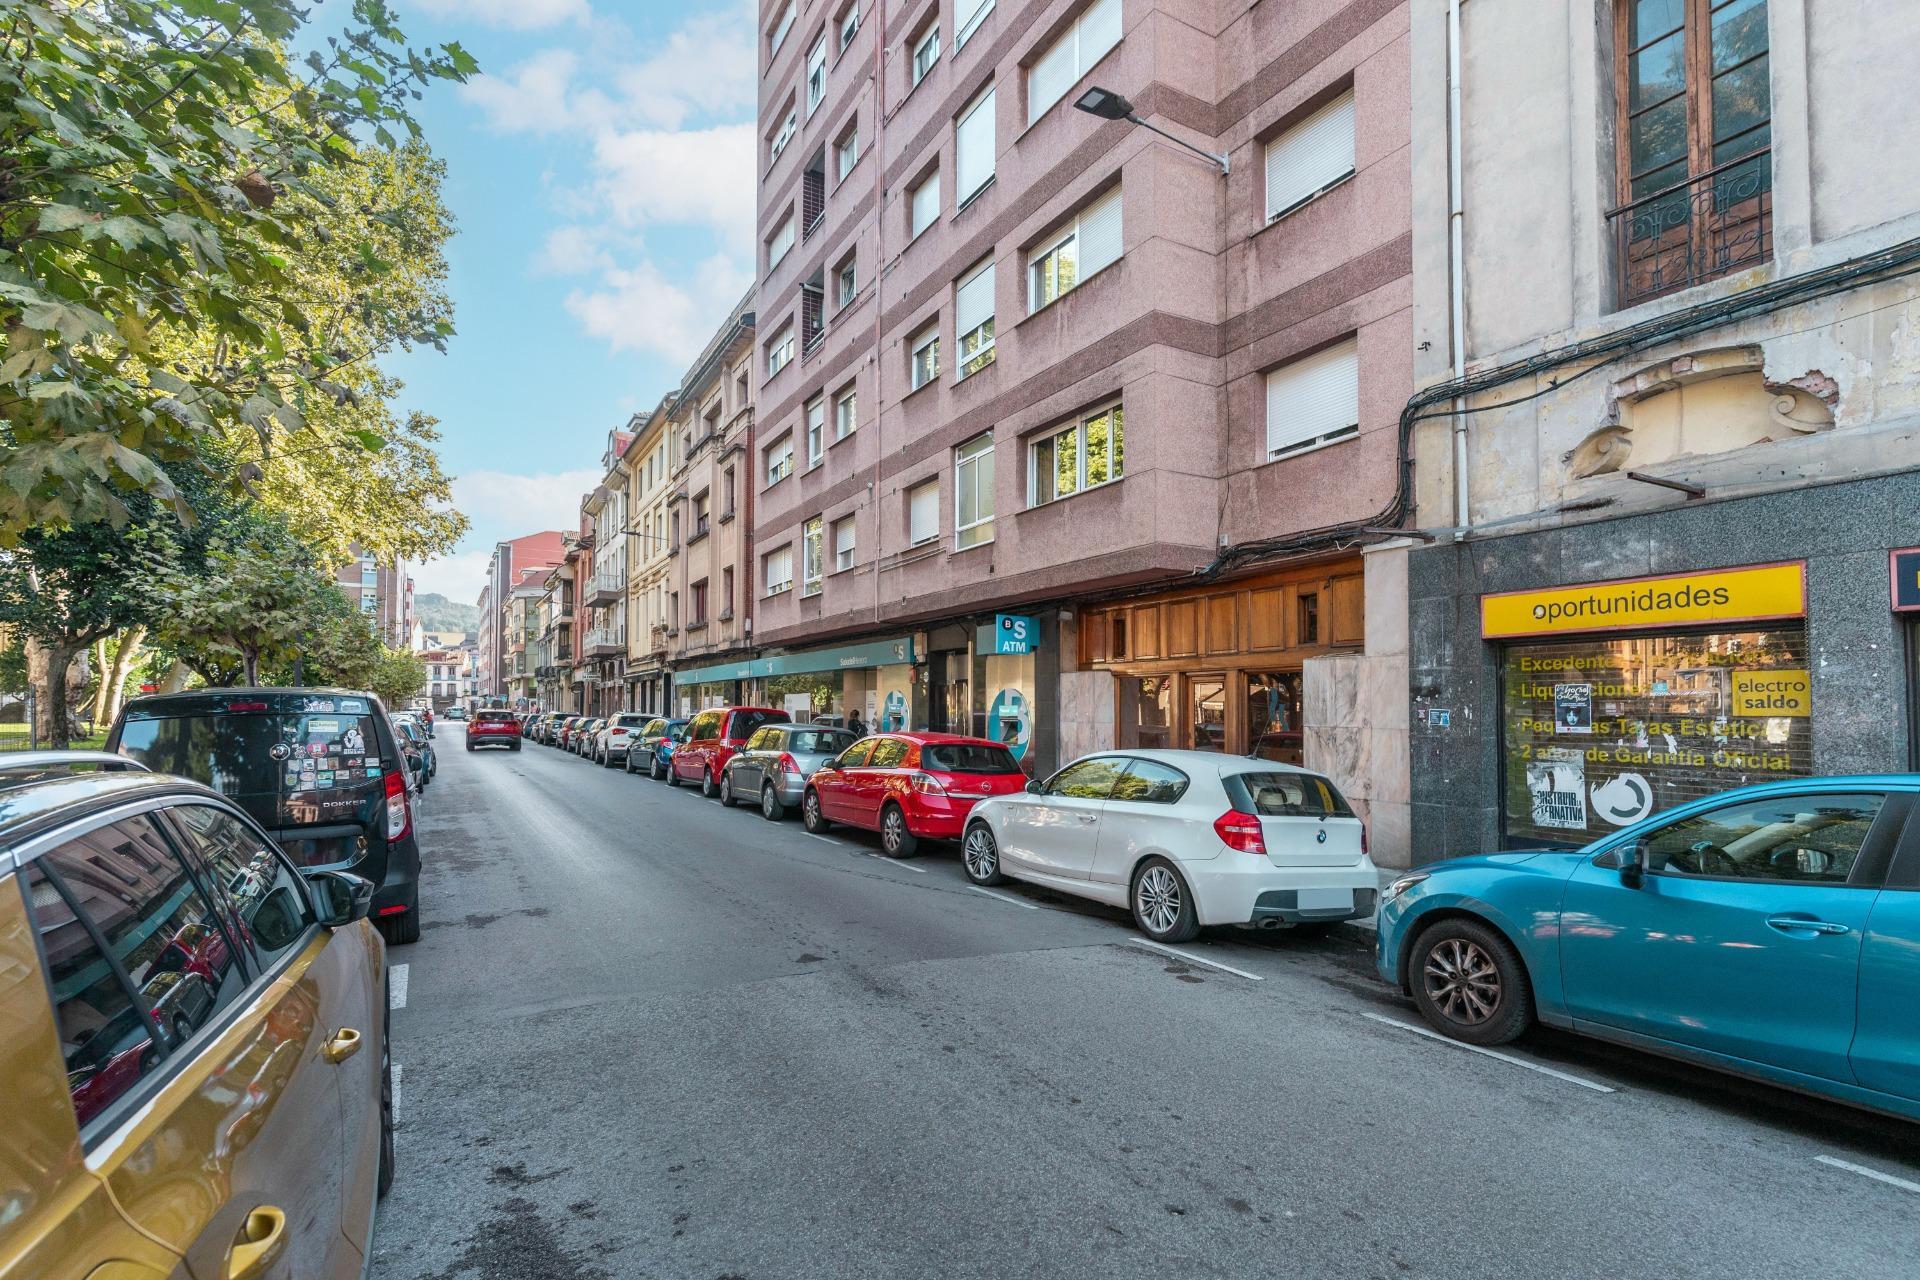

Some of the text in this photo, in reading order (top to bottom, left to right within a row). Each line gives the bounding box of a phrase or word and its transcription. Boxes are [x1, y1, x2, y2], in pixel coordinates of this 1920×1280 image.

[1533, 585, 1729, 623] oportunidades
[1002, 641, 1026, 653] ATM
[1521, 655, 1621, 672] Excedente
[1738, 679, 1806, 693] electro
[1744, 695, 1800, 710] saldo
[1522, 718, 1610, 736] Peqas
[1521, 745, 1531, 759] 2
[1586, 747, 1609, 762] de
[323, 799, 367, 808] DOKKER
[1537, 790, 1577, 807] ONSTRUIR
